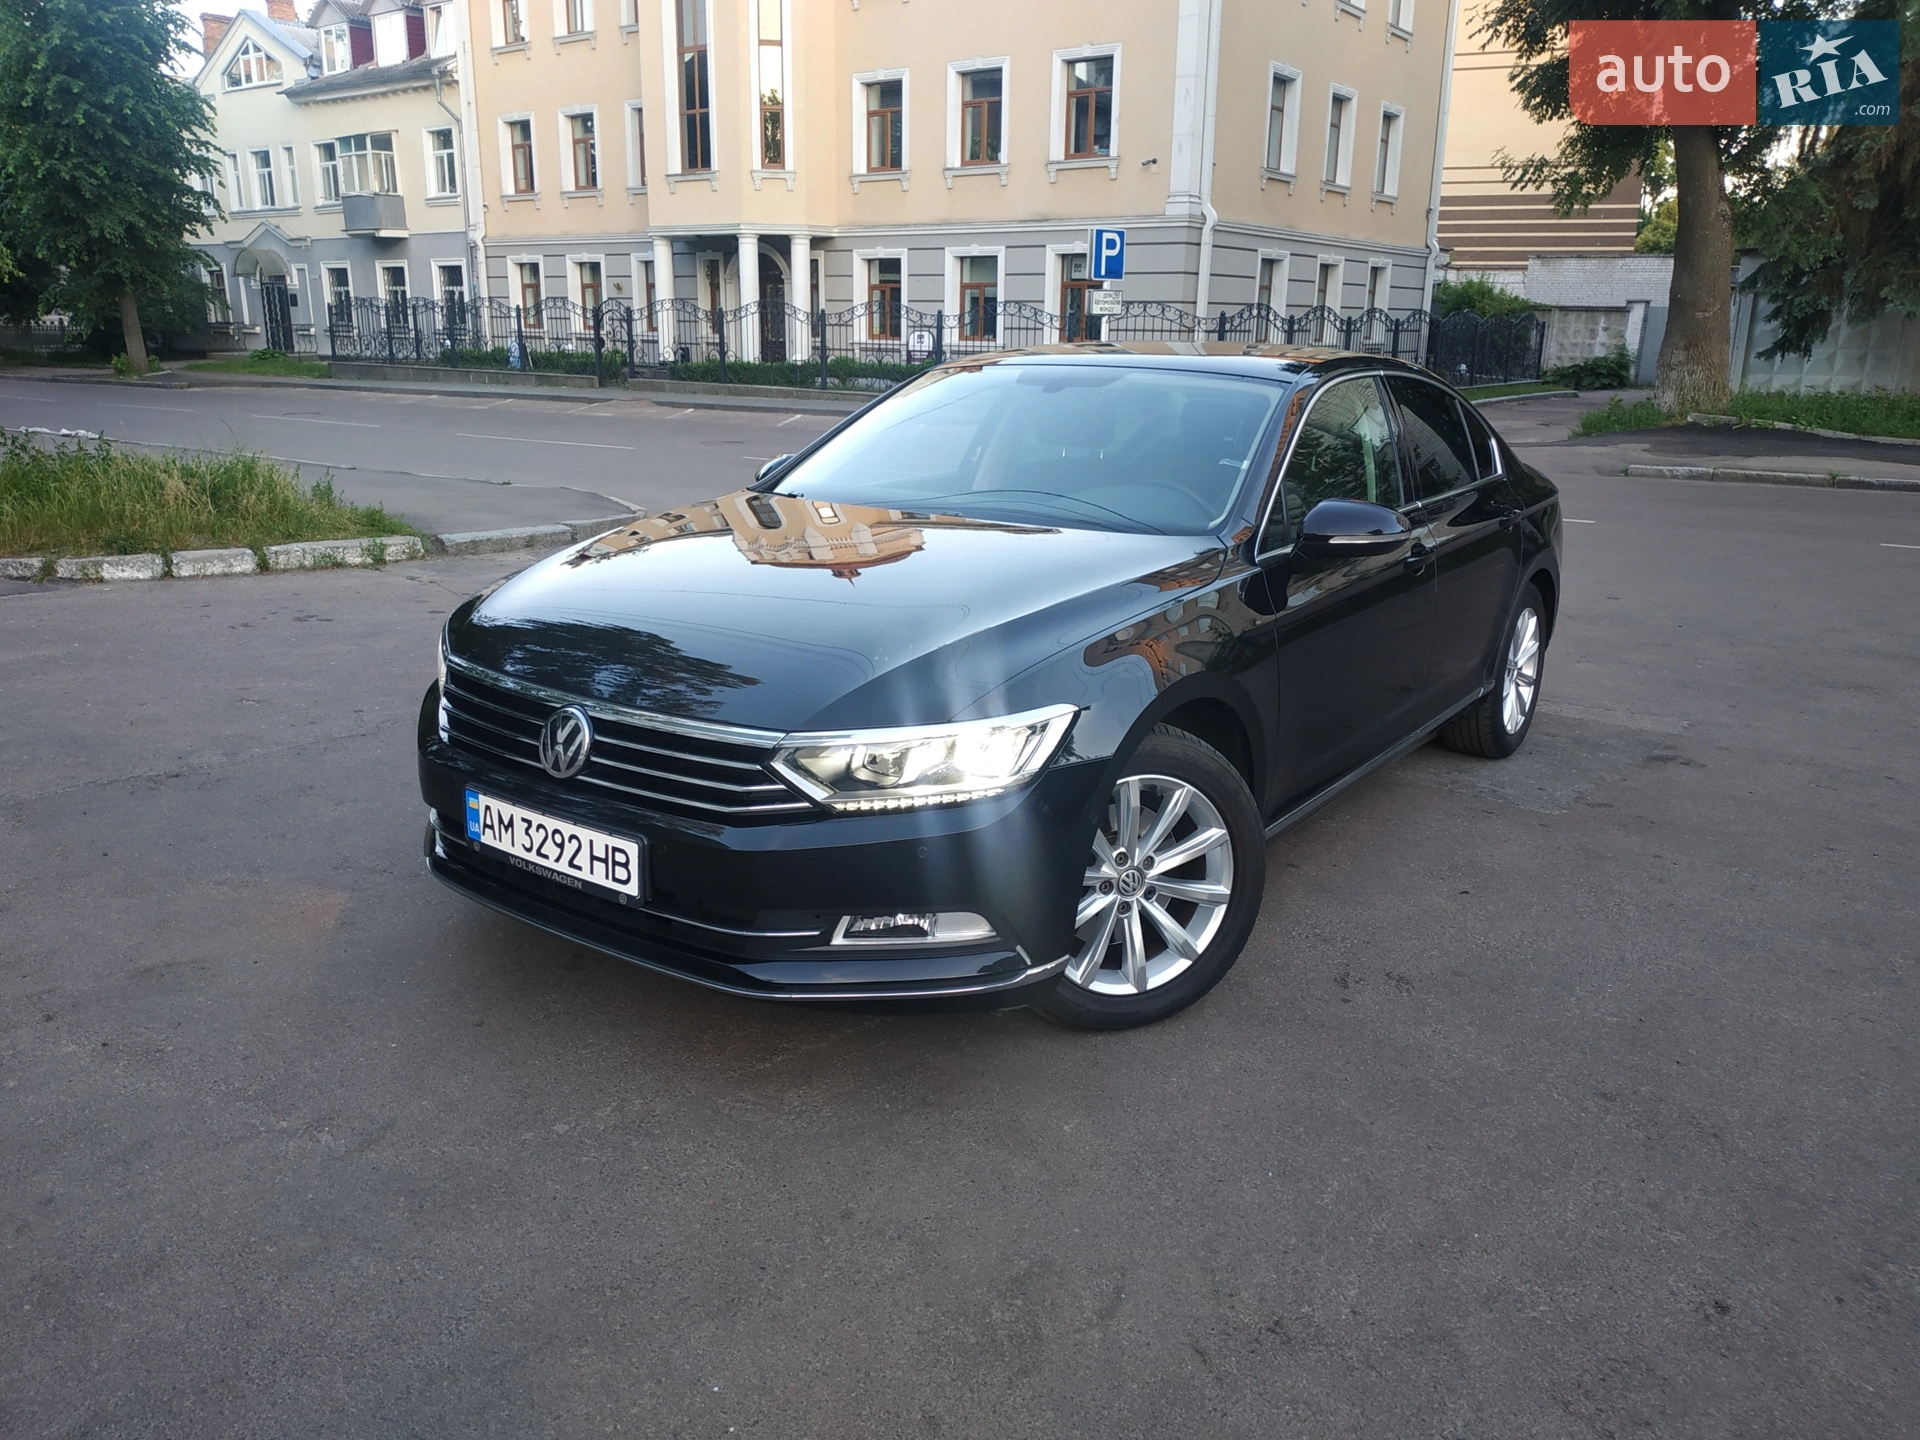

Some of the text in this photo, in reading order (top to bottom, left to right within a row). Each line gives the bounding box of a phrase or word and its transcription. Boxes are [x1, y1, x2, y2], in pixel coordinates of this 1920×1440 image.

[1101, 232, 1121, 276] P
[470, 821, 480, 833] UA
[481, 804, 632, 886] AM 3292 HB
[509, 855, 583, 890] VOLKSWAGEN
